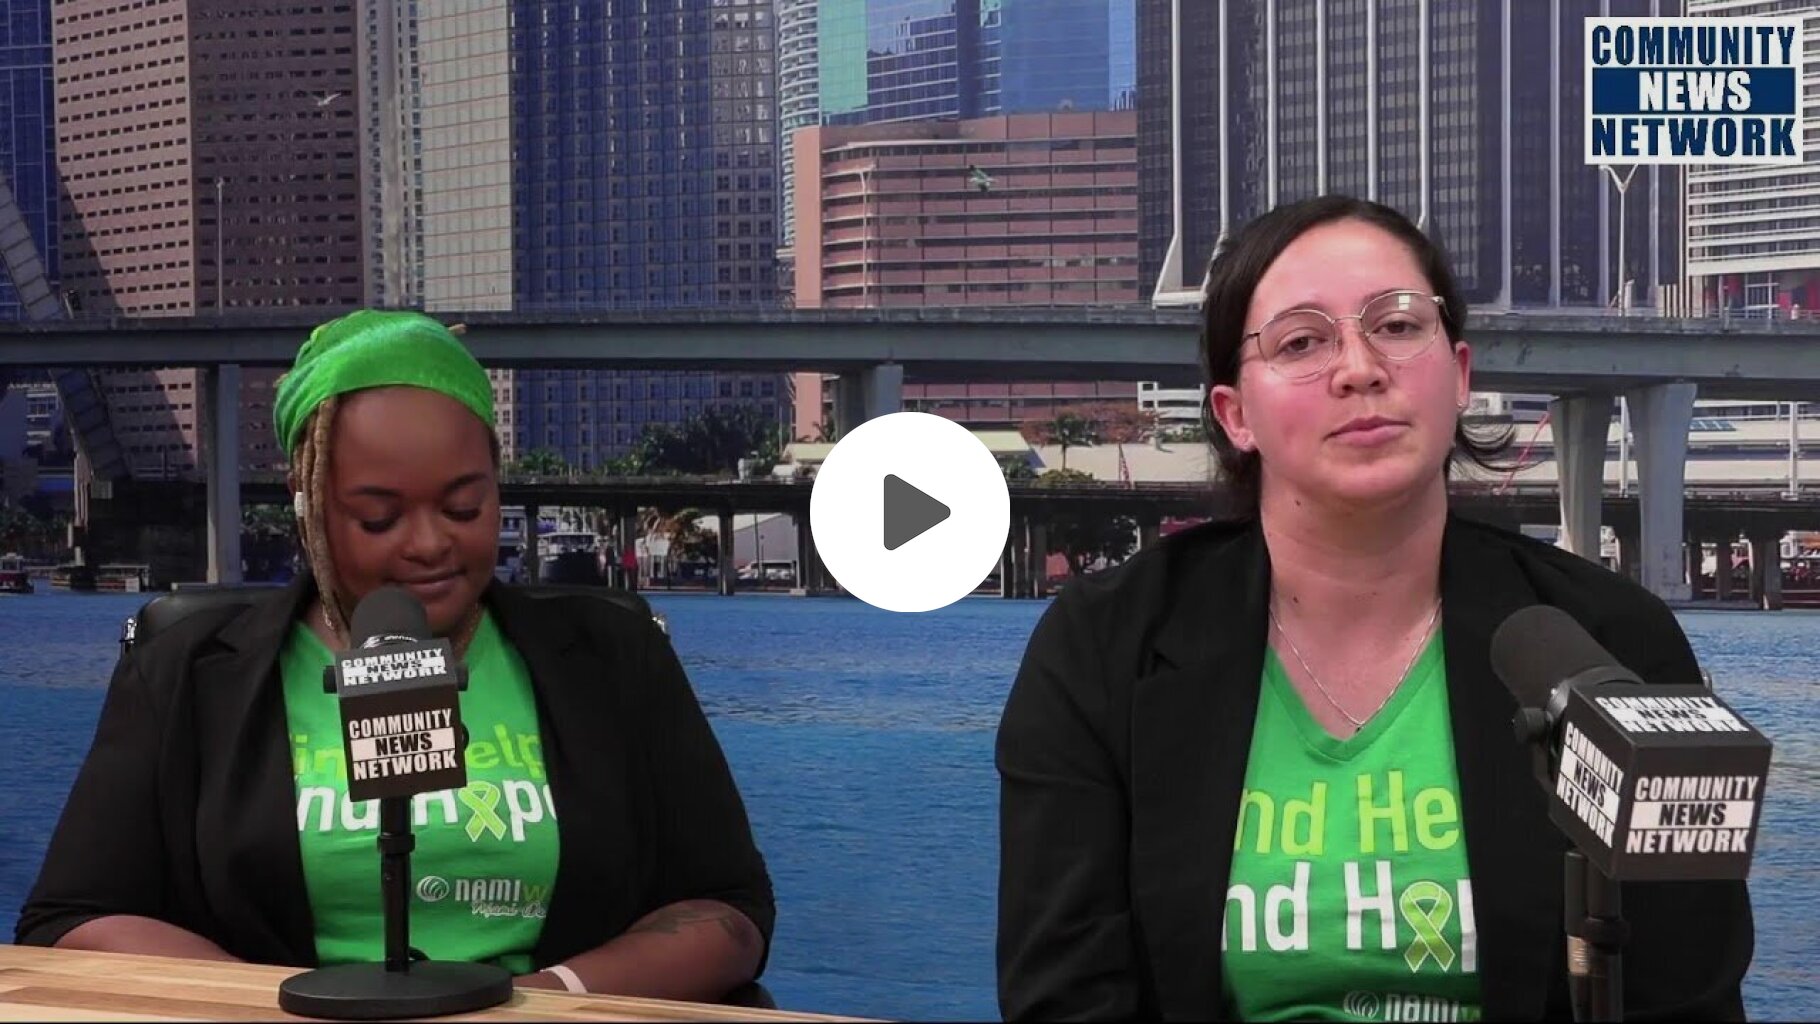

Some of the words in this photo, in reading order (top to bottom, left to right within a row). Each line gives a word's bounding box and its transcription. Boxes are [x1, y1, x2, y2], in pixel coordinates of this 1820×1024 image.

[341, 648, 443, 668] COMMUNITY
[367, 660, 422, 674] NEWS
[343, 666, 447, 686] NETWORK
[349, 708, 452, 739] COMMUNITY
[375, 733, 432, 757] NEWS
[465, 724, 546, 778] elp
[1565, 721, 1624, 792] COMMUNITY
[353, 751, 458, 781] NETWORK
[1574, 760, 1606, 807] NEWS
[1635, 776, 1759, 800] COMMUNITY
[1234, 781, 1327, 855] nd
[1357, 770, 1459, 853] He
[1557, 773, 1615, 848] NETWORK
[1659, 803, 1727, 826] NEWS
[1626, 829, 1750, 853] NETWORK
[1221, 861, 1311, 952] nd
